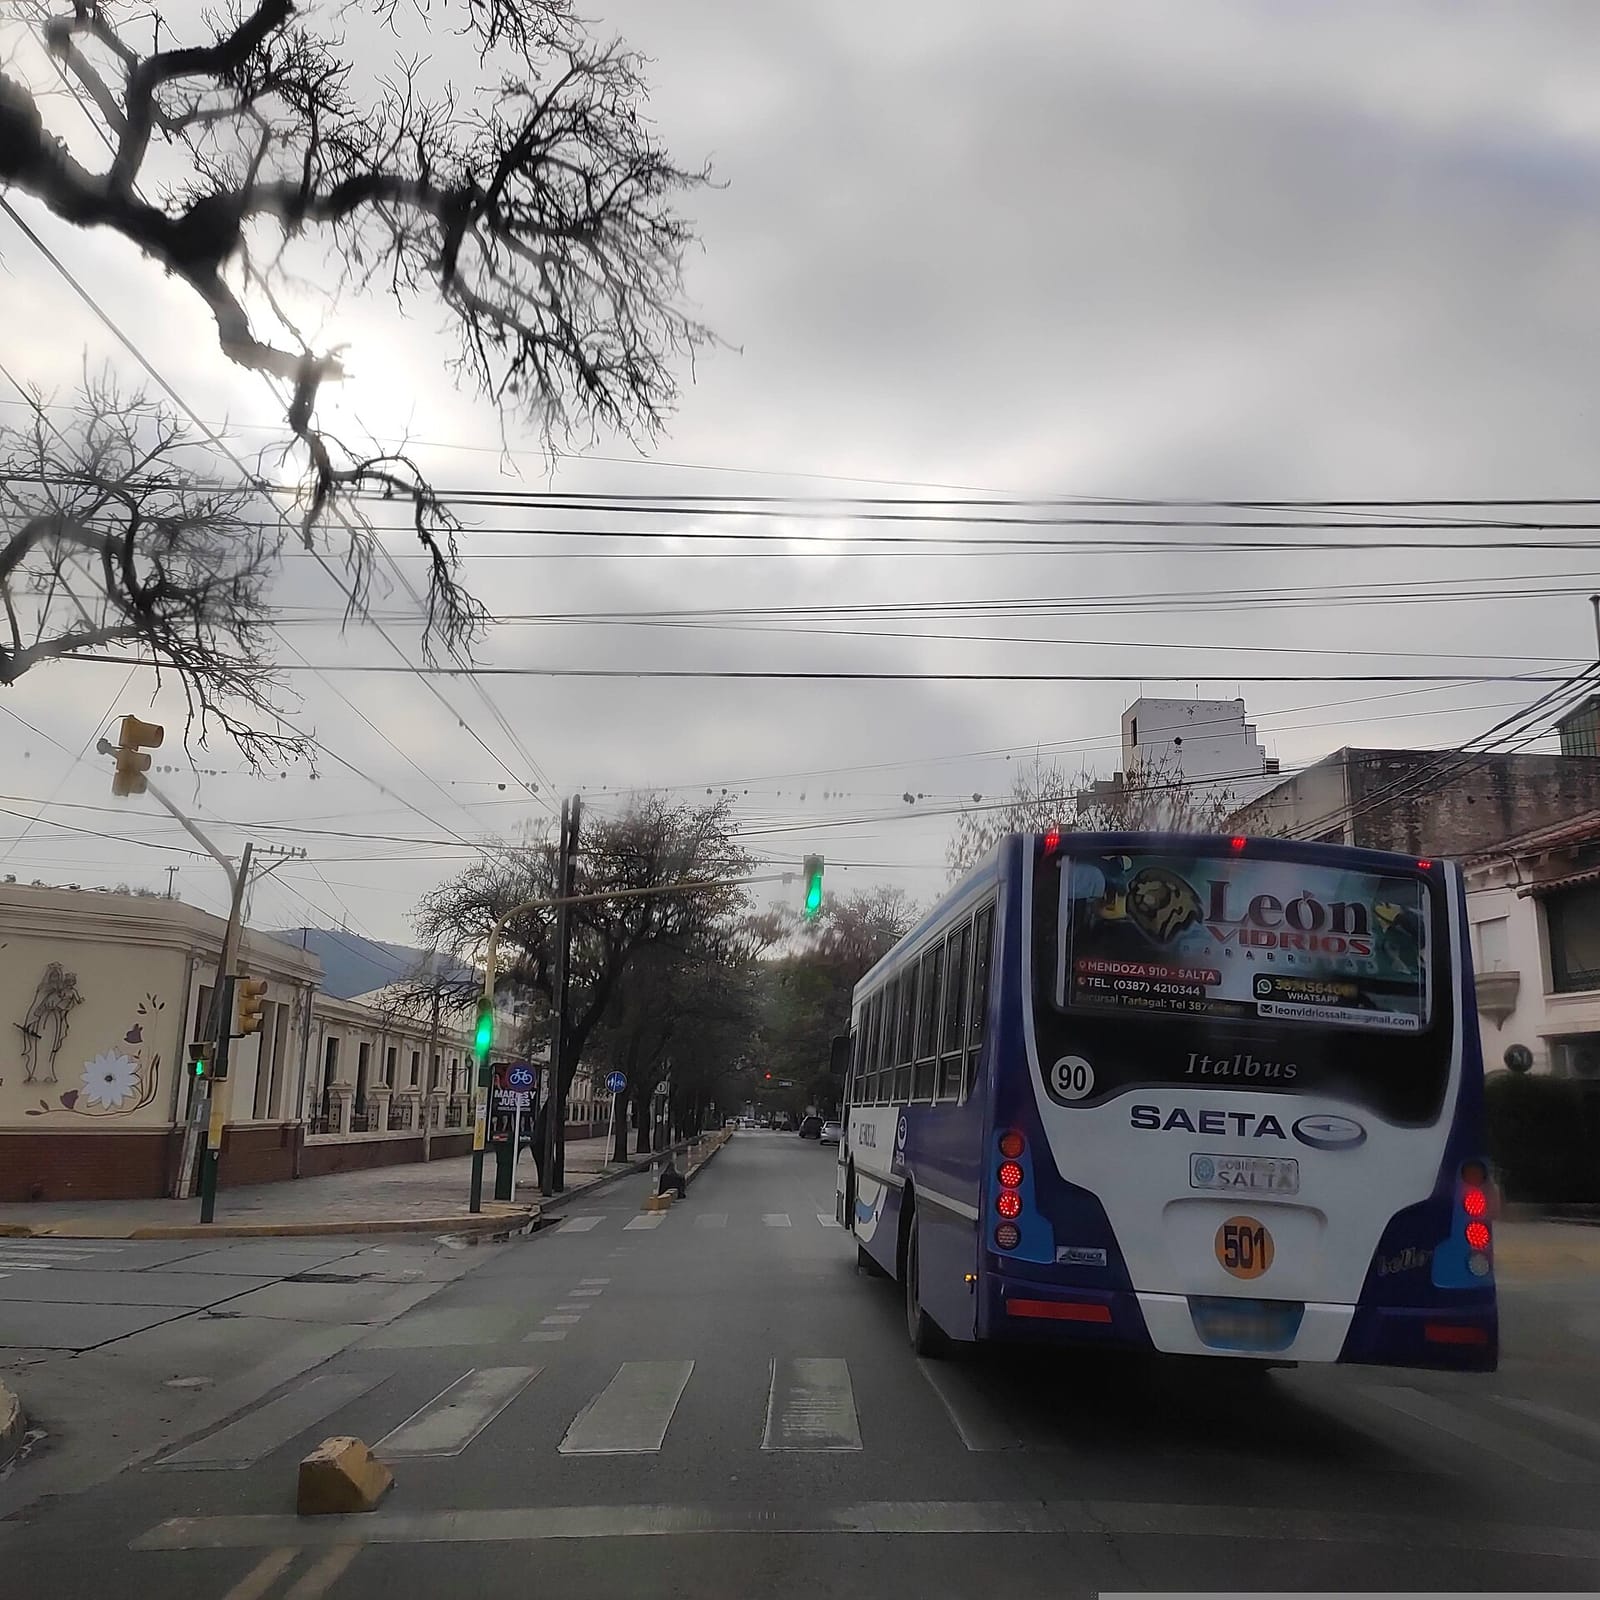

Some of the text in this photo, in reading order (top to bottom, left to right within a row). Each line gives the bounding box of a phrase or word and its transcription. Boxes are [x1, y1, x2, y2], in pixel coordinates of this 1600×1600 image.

[1205, 879, 1371, 936] León
[1206, 925, 1372, 957] VIDRIOS
[1087, 961, 1146, 975] MENDOZA
[1148, 966, 1168, 977] 910
[1178, 969, 1216, 981] SALTA
[1087, 977, 1201, 996] TEL. (0387) 4210344
[1122, 995, 1168, 1008] Tartagal:
[1170, 1000, 1186, 1010] Tel
[1058, 1064, 1088, 1092] 90
[1186, 1052, 1298, 1079] Italbus
[1130, 1105, 1287, 1139] SAETA
[1223, 1225, 1267, 1270] 501
